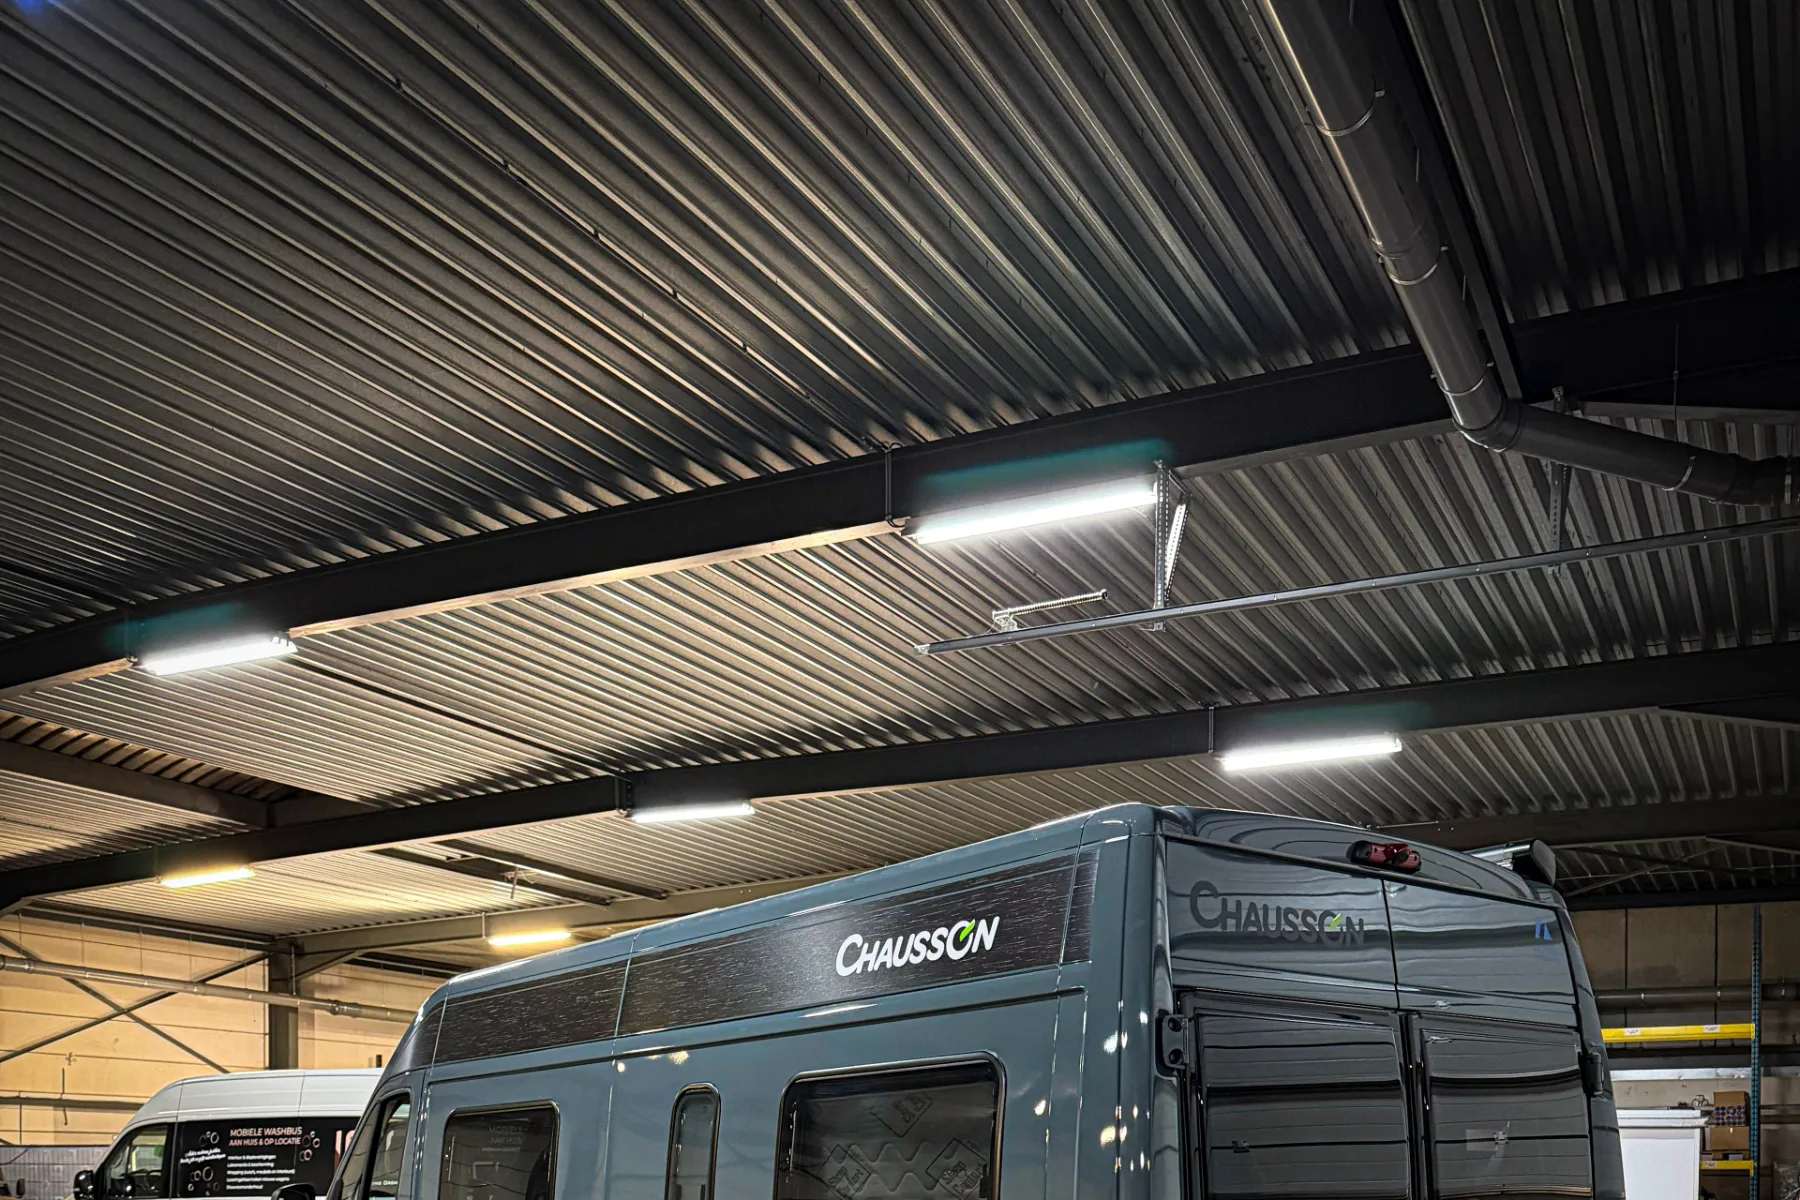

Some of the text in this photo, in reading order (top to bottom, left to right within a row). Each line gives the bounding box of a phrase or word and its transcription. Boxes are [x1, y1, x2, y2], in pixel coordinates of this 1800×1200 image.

[1190, 880, 1364, 945] CHAUSSON
[835, 916, 1000, 977] CHAUSSON
[230, 1126, 303, 1137] MOBIELE WASHBUS
[243, 1138, 258, 1146] HUIS
[274, 1137, 301, 1145] LOCATIE
